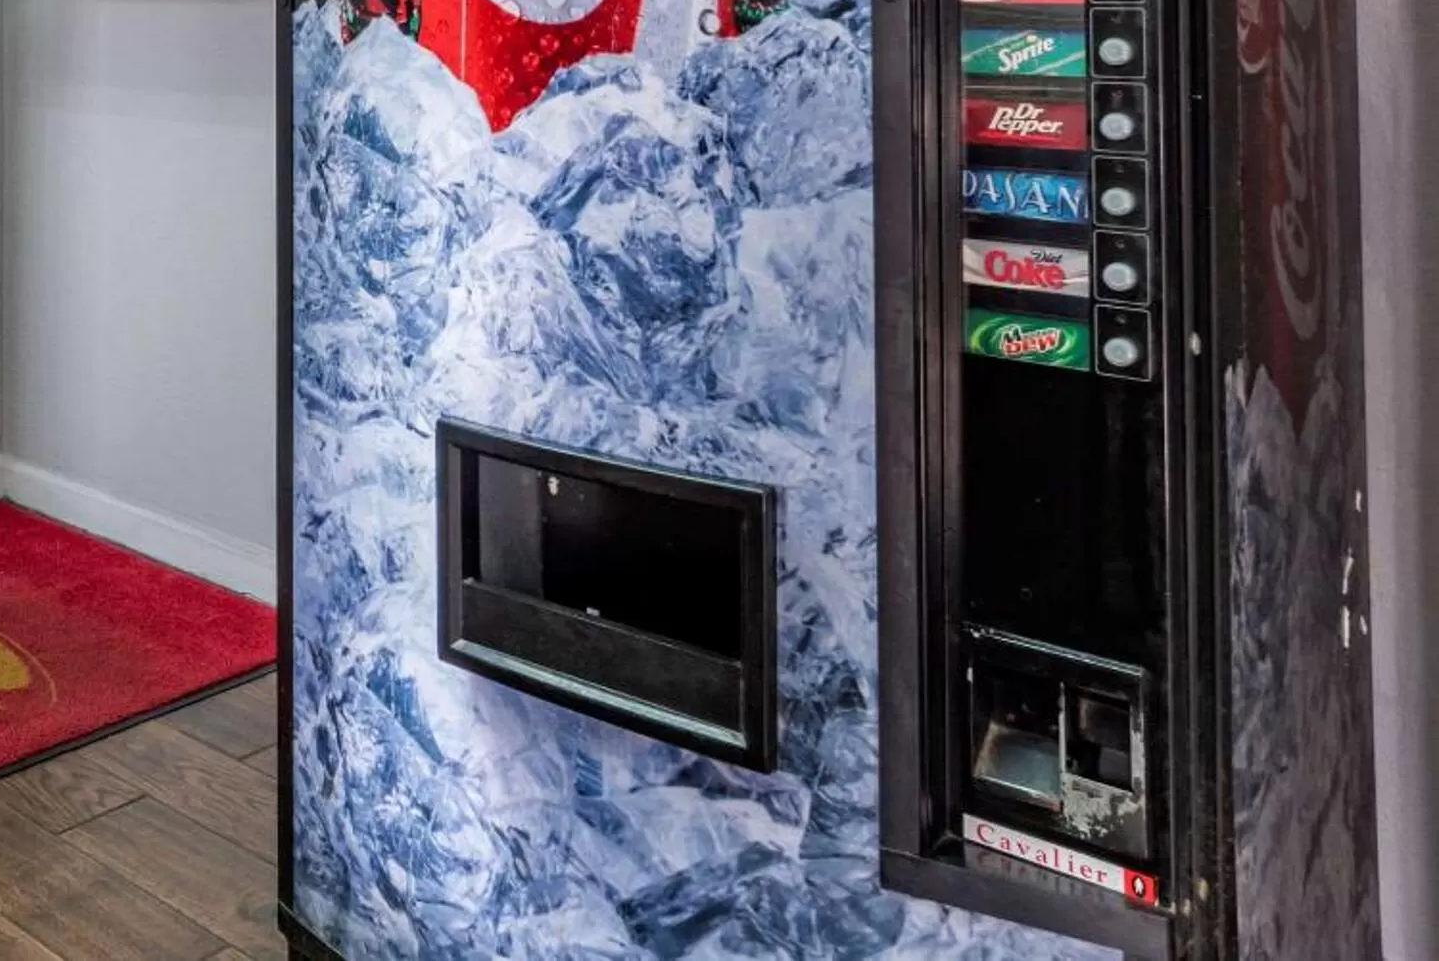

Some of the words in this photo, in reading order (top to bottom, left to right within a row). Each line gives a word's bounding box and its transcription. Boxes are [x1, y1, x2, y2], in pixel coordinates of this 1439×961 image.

[997, 34, 1056, 73] Sprite
[988, 106, 1063, 135] Pepper
[1014, 103, 1045, 120] Dr
[984, 249, 1065, 290] Coke
[976, 823, 1108, 883] Cavalier
